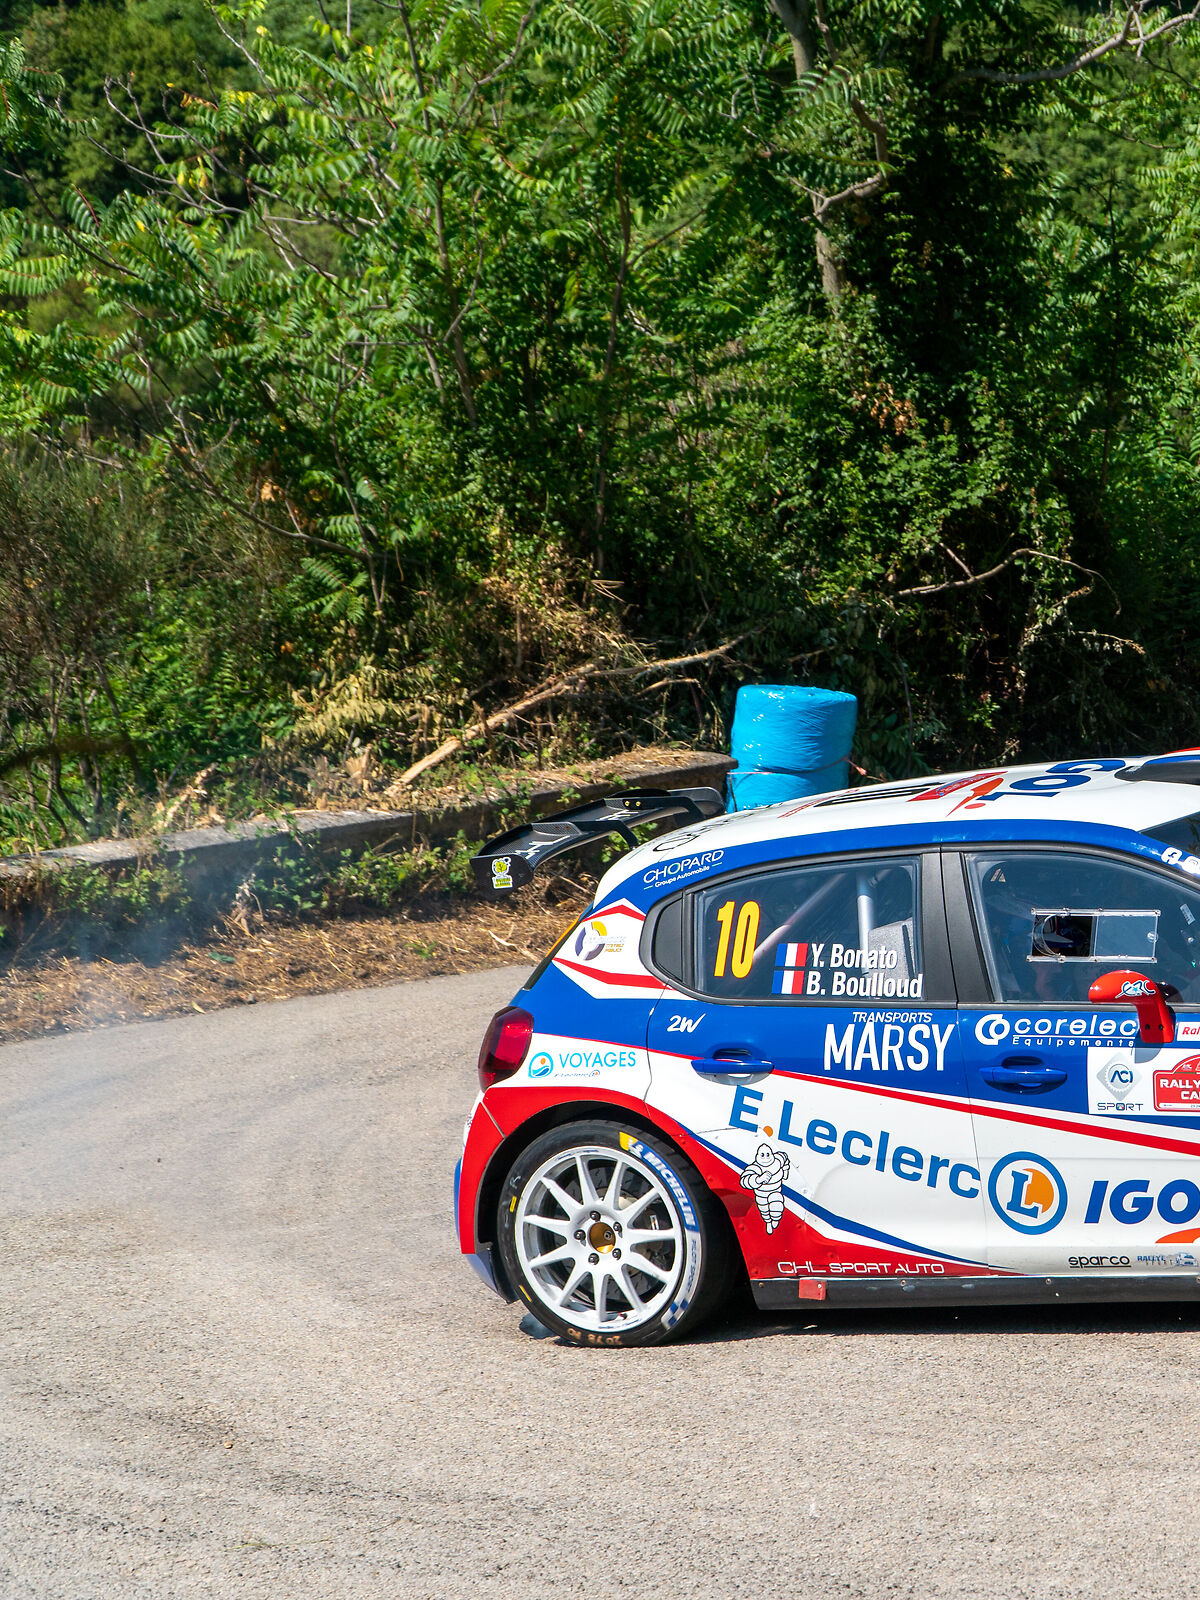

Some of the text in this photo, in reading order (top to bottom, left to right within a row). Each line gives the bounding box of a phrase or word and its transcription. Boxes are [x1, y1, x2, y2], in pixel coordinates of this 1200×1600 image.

[643, 849, 725, 884] CHOPARD
[655, 865, 710, 888] Groupe Automobile
[714, 901, 760, 978] 10
[811, 943, 898, 969] Y. Bonato
[806, 971, 923, 998] B. Boulloud
[852, 1011, 933, 1023] TRANSPORTS
[1014, 1014, 1137, 1035] corelec
[824, 1023, 955, 1071] MARSY
[1012, 1036, 1135, 1047] Equipements
[559, 1051, 637, 1068] VOYAGES
[1110, 1070, 1133, 1083] ACI
[1097, 1102, 1144, 1112] SPORT
[728, 1084, 982, 1199] E.Leclerc
[645, 1150, 697, 1228] MICHELIN
[777, 1261, 945, 1274] CHL SPORT AUTO
[1068, 1255, 1131, 1268] sparco
